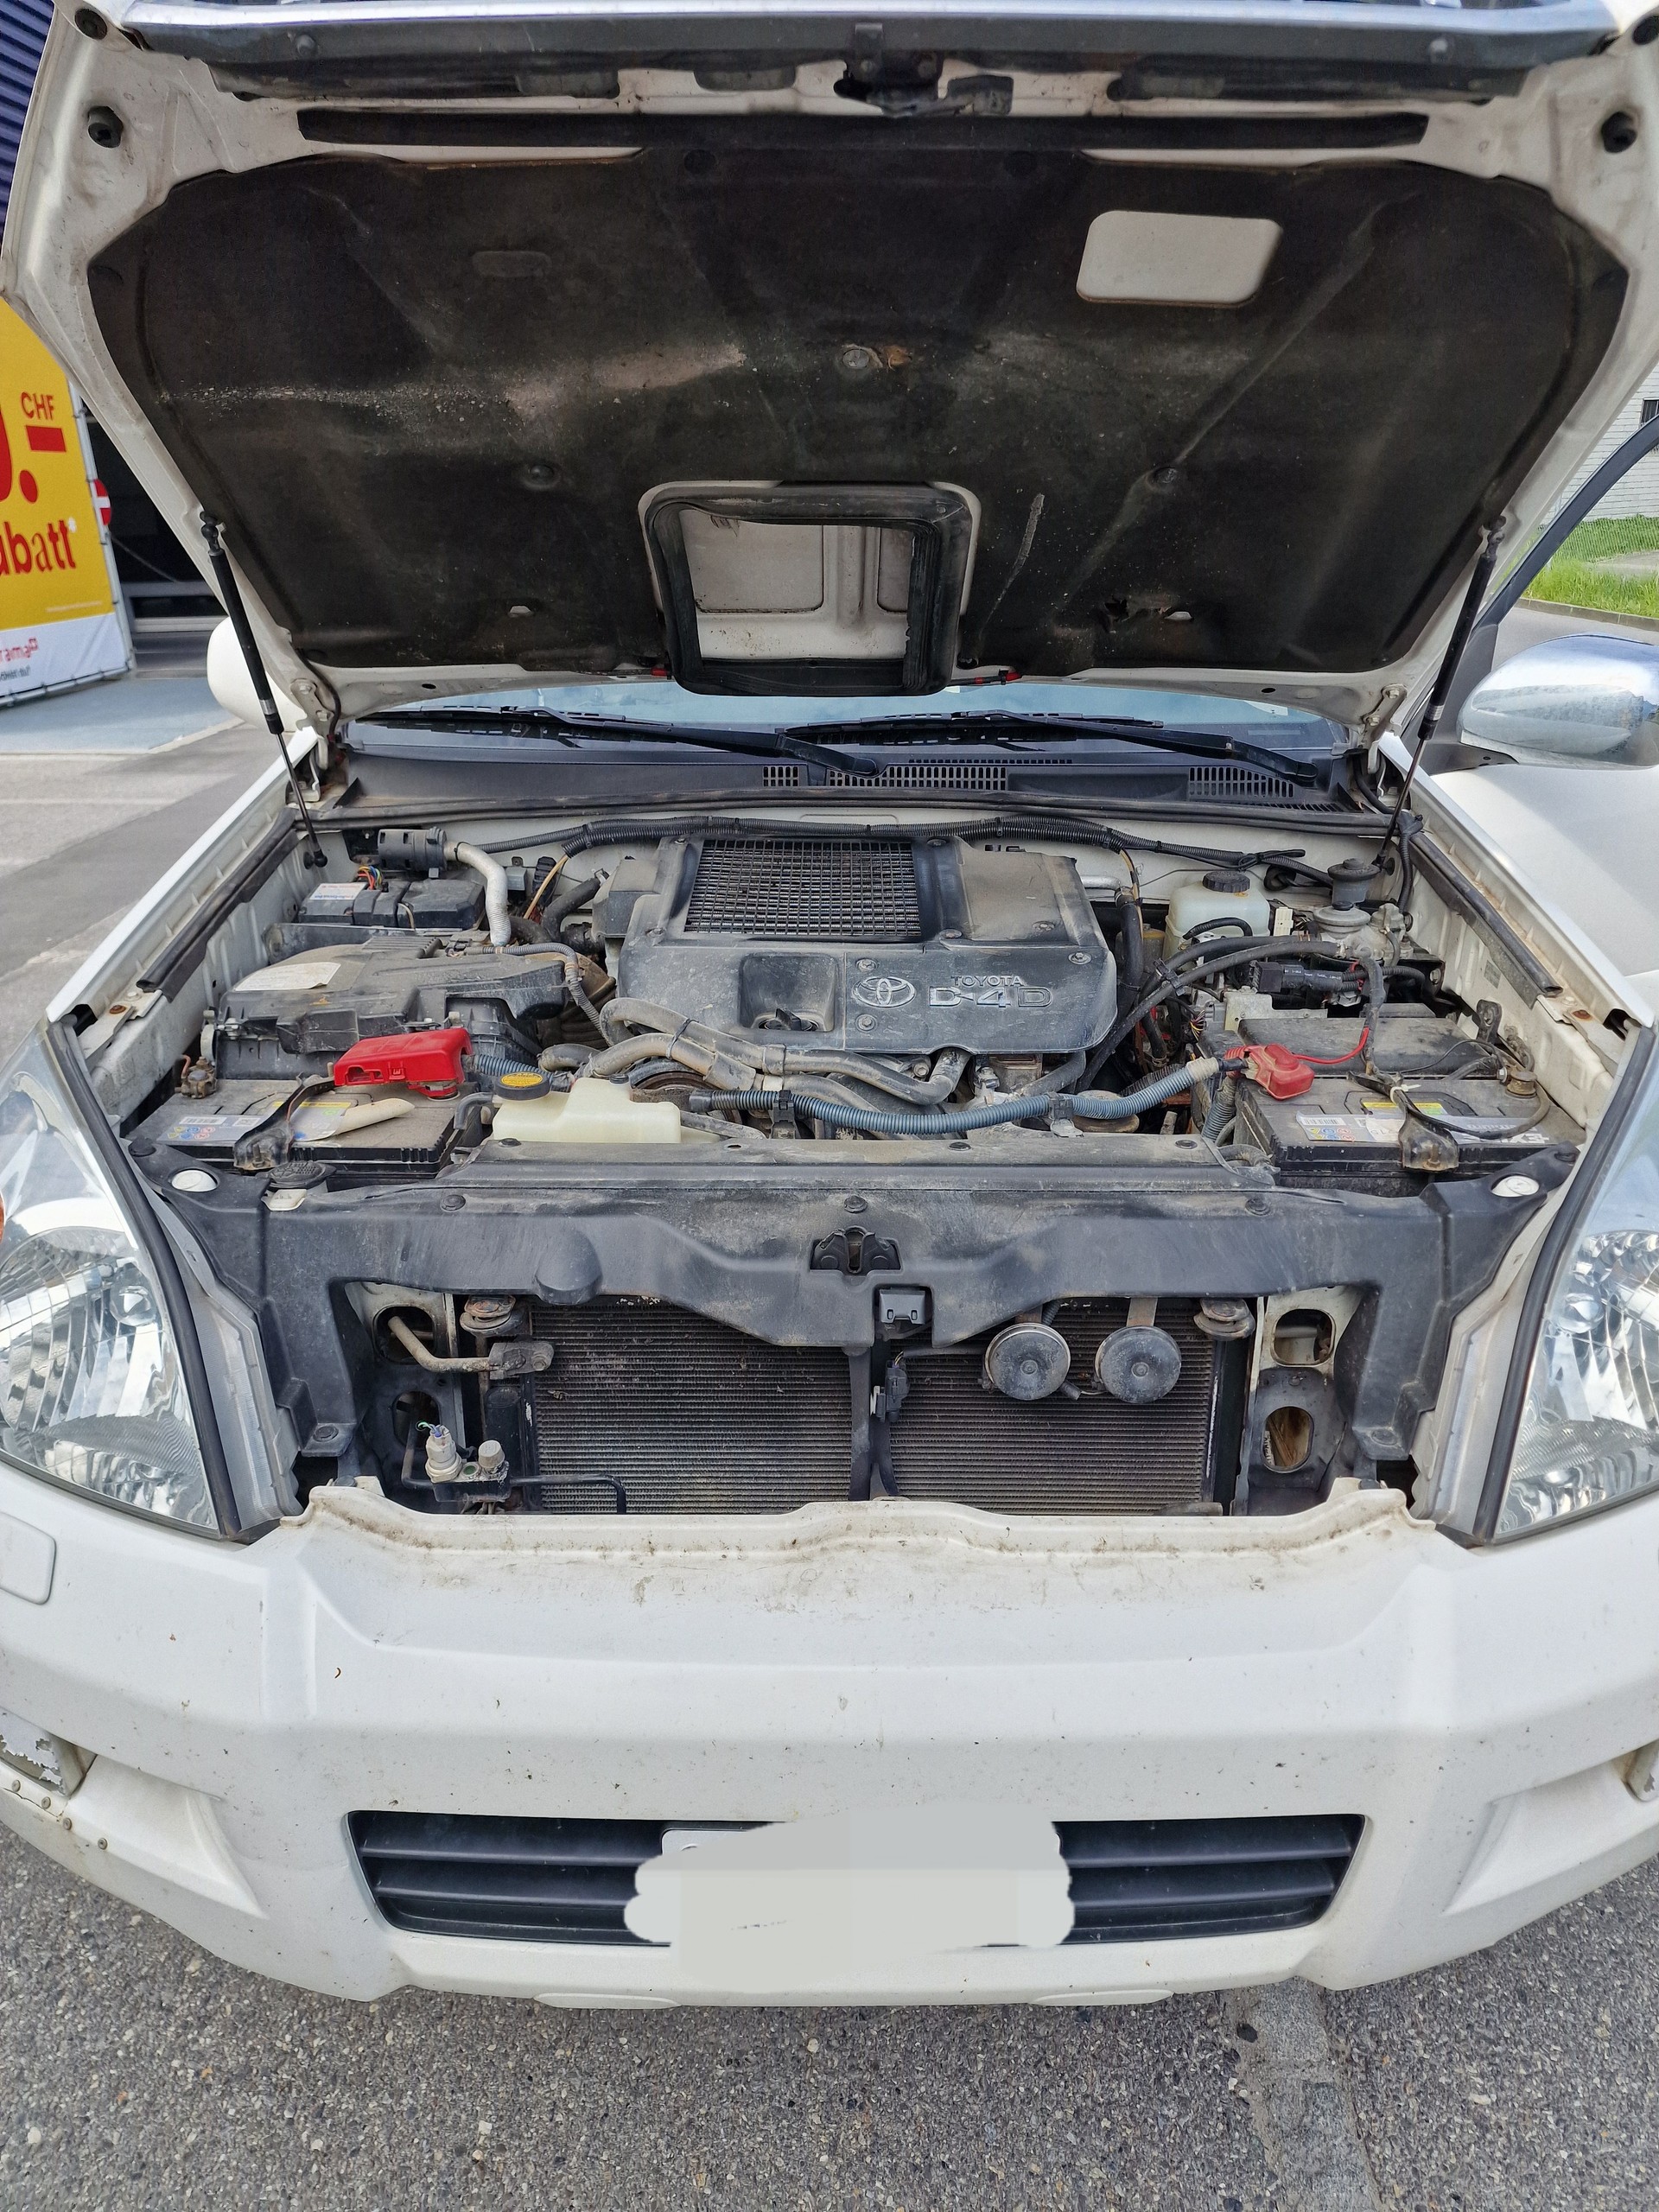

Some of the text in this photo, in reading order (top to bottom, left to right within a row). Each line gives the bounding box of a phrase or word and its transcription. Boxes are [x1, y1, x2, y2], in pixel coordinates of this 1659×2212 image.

[20, 391, 54, 421] CHF
[950, 975, 1026, 987] TOYOTA
[928, 986, 1052, 1007] D-4D
